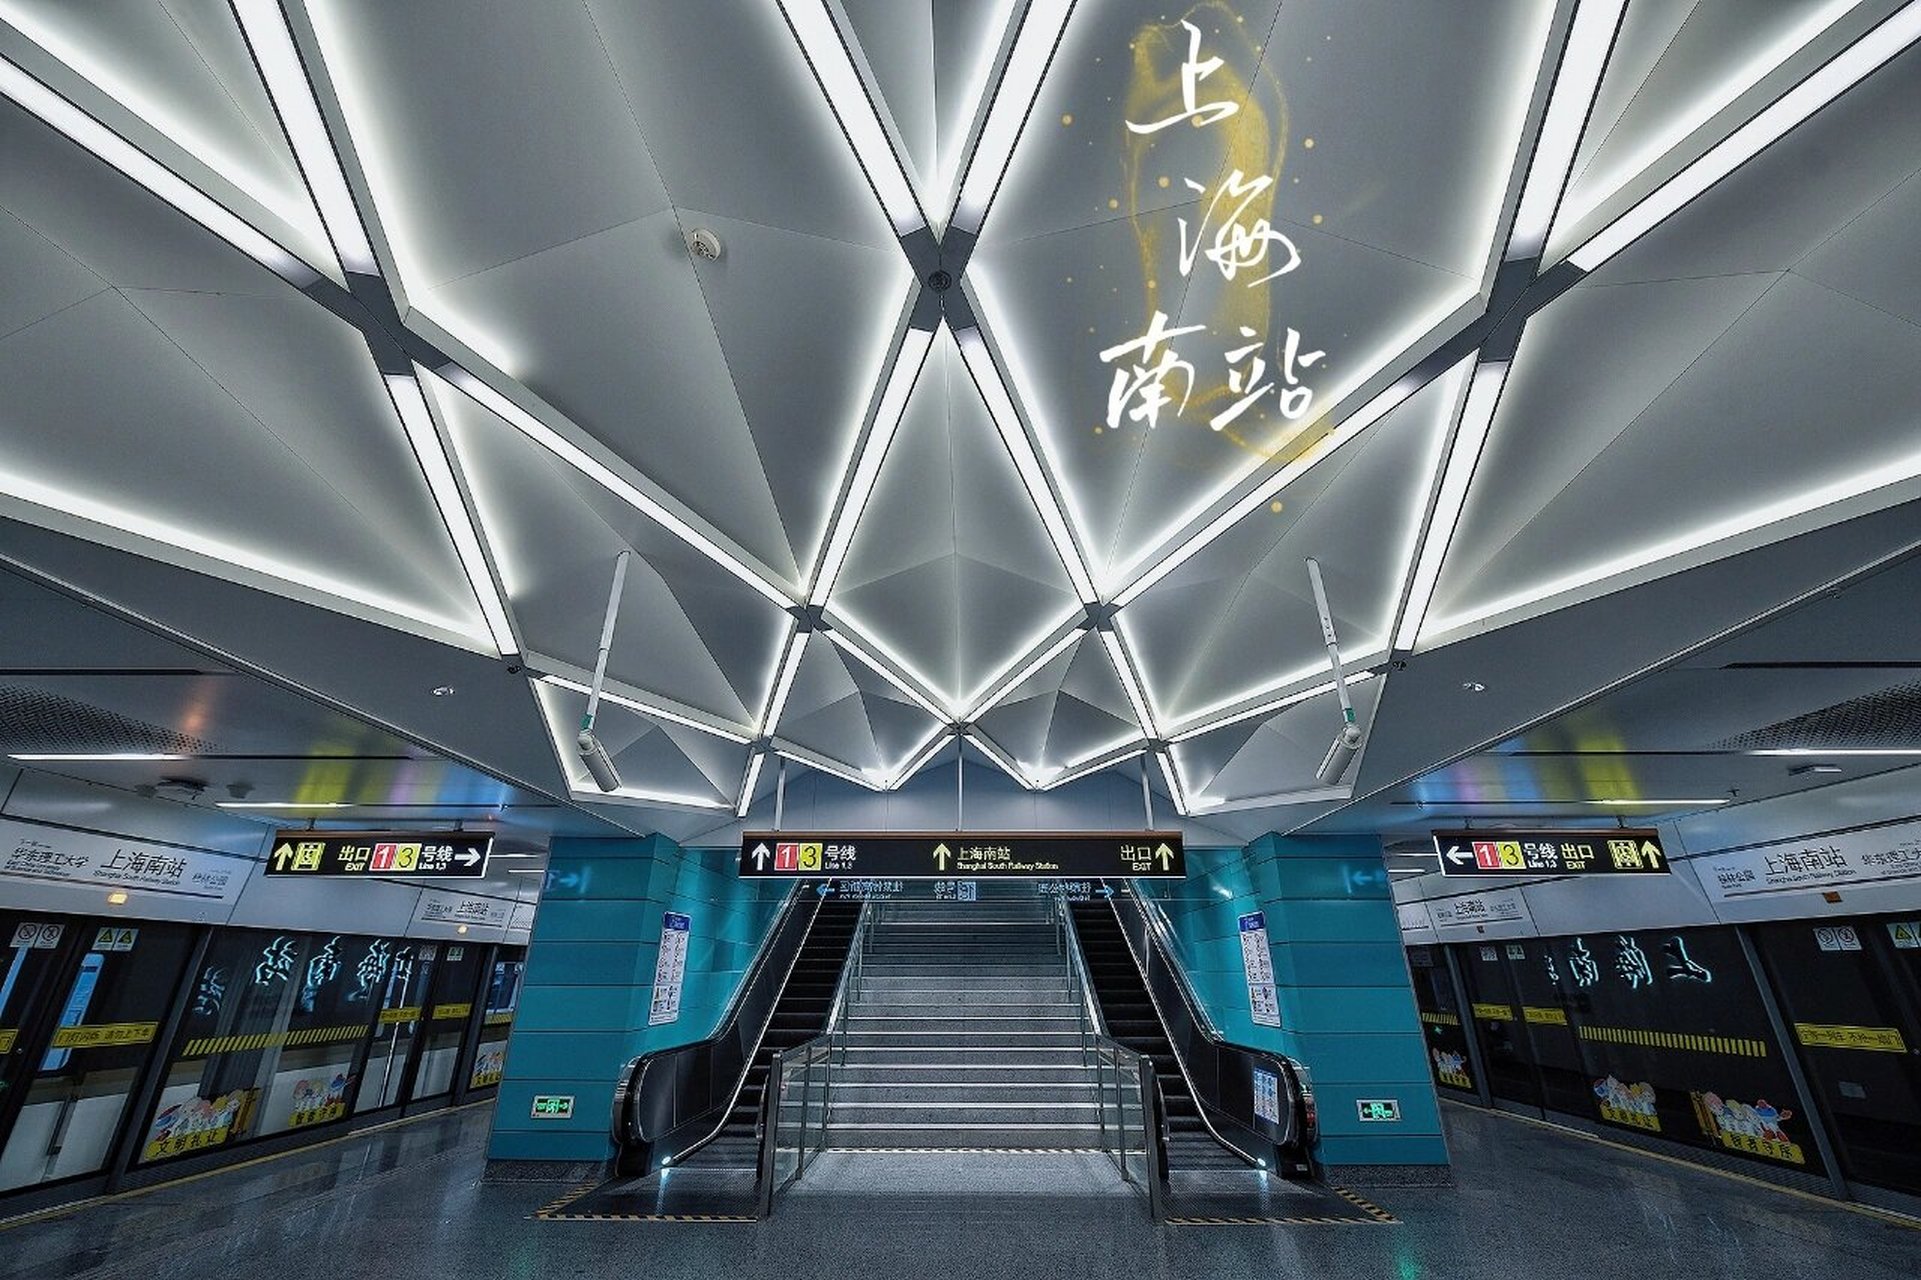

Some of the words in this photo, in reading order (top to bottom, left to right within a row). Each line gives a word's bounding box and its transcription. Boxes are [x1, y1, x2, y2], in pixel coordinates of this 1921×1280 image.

[12, 847, 89, 868] 华东理工大学
[338, 845, 371, 861] 出口
[422, 845, 454, 862] 号线
[824, 845, 856, 861] 号线
[957, 846, 1011, 861] 上海南站
[1121, 845, 1151, 861] 出口
[1524, 842, 1559, 860] 号线
[1561, 842, 1595, 860] 出口
[100, 848, 187, 879] 上海南站
[344, 862, 365, 871] EXIT
[957, 862, 987, 871] Shanghai
[987, 862, 1007, 870] South
[1008, 862, 1034, 871] Railway
[1035, 862, 1059, 870] Station
[1132, 862, 1151, 871] EXIT
[1566, 860, 1586, 869] EXIT
[1764, 846, 1847, 876] 上海南站
